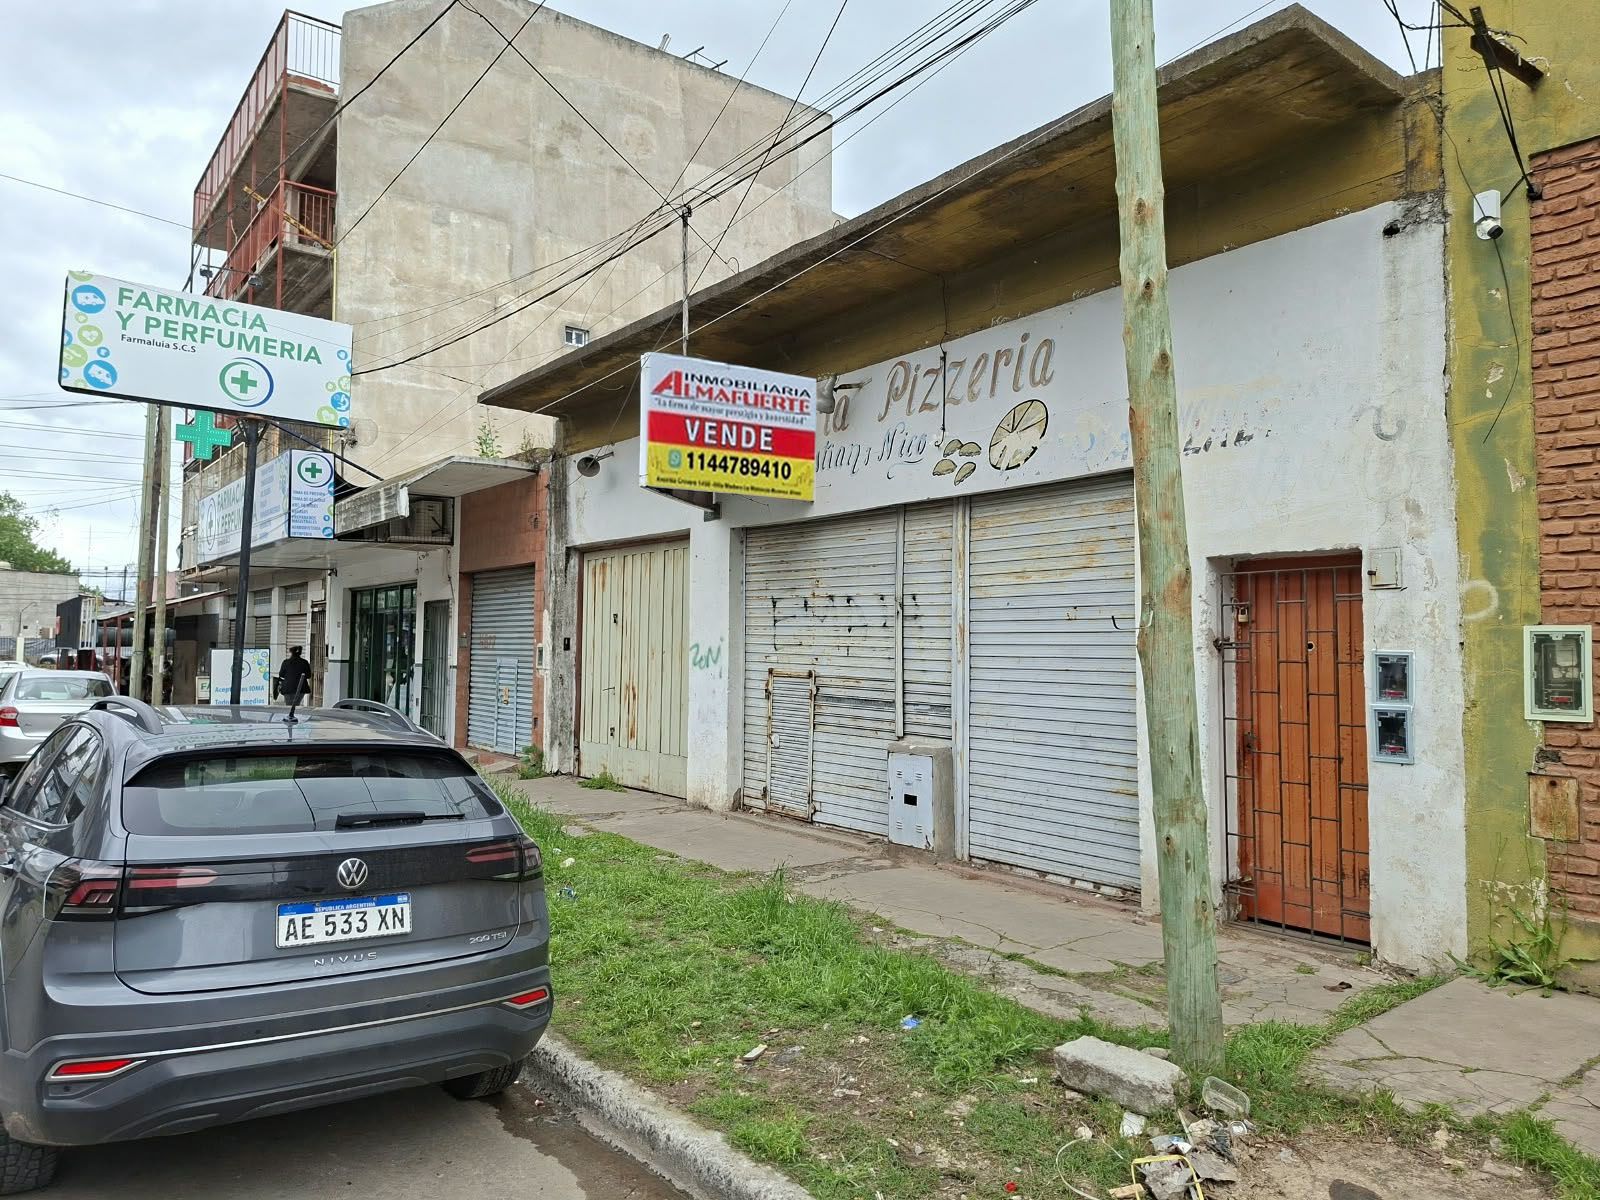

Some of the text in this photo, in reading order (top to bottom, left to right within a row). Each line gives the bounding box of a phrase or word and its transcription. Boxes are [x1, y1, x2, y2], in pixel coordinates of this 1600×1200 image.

[117, 287, 268, 333] FARMACIA
[115, 310, 323, 365] Y PERFUMERIA
[121, 334, 170, 349] Farmaluia
[651, 370, 811, 413] ALMAFUERTE
[685, 372, 811, 398] INMOBILIARIA
[878, 332, 1056, 422] Pizzeria
[668, 400, 689, 410] firma
[690, 402, 699, 411] de
[685, 419, 773, 451] VENDE
[686, 450, 791, 480] 1144789410
[345, 902, 376, 910] ARGENTINA
[285, 906, 405, 941] AE 533 XN
[313, 951, 377, 967] NIVUS
